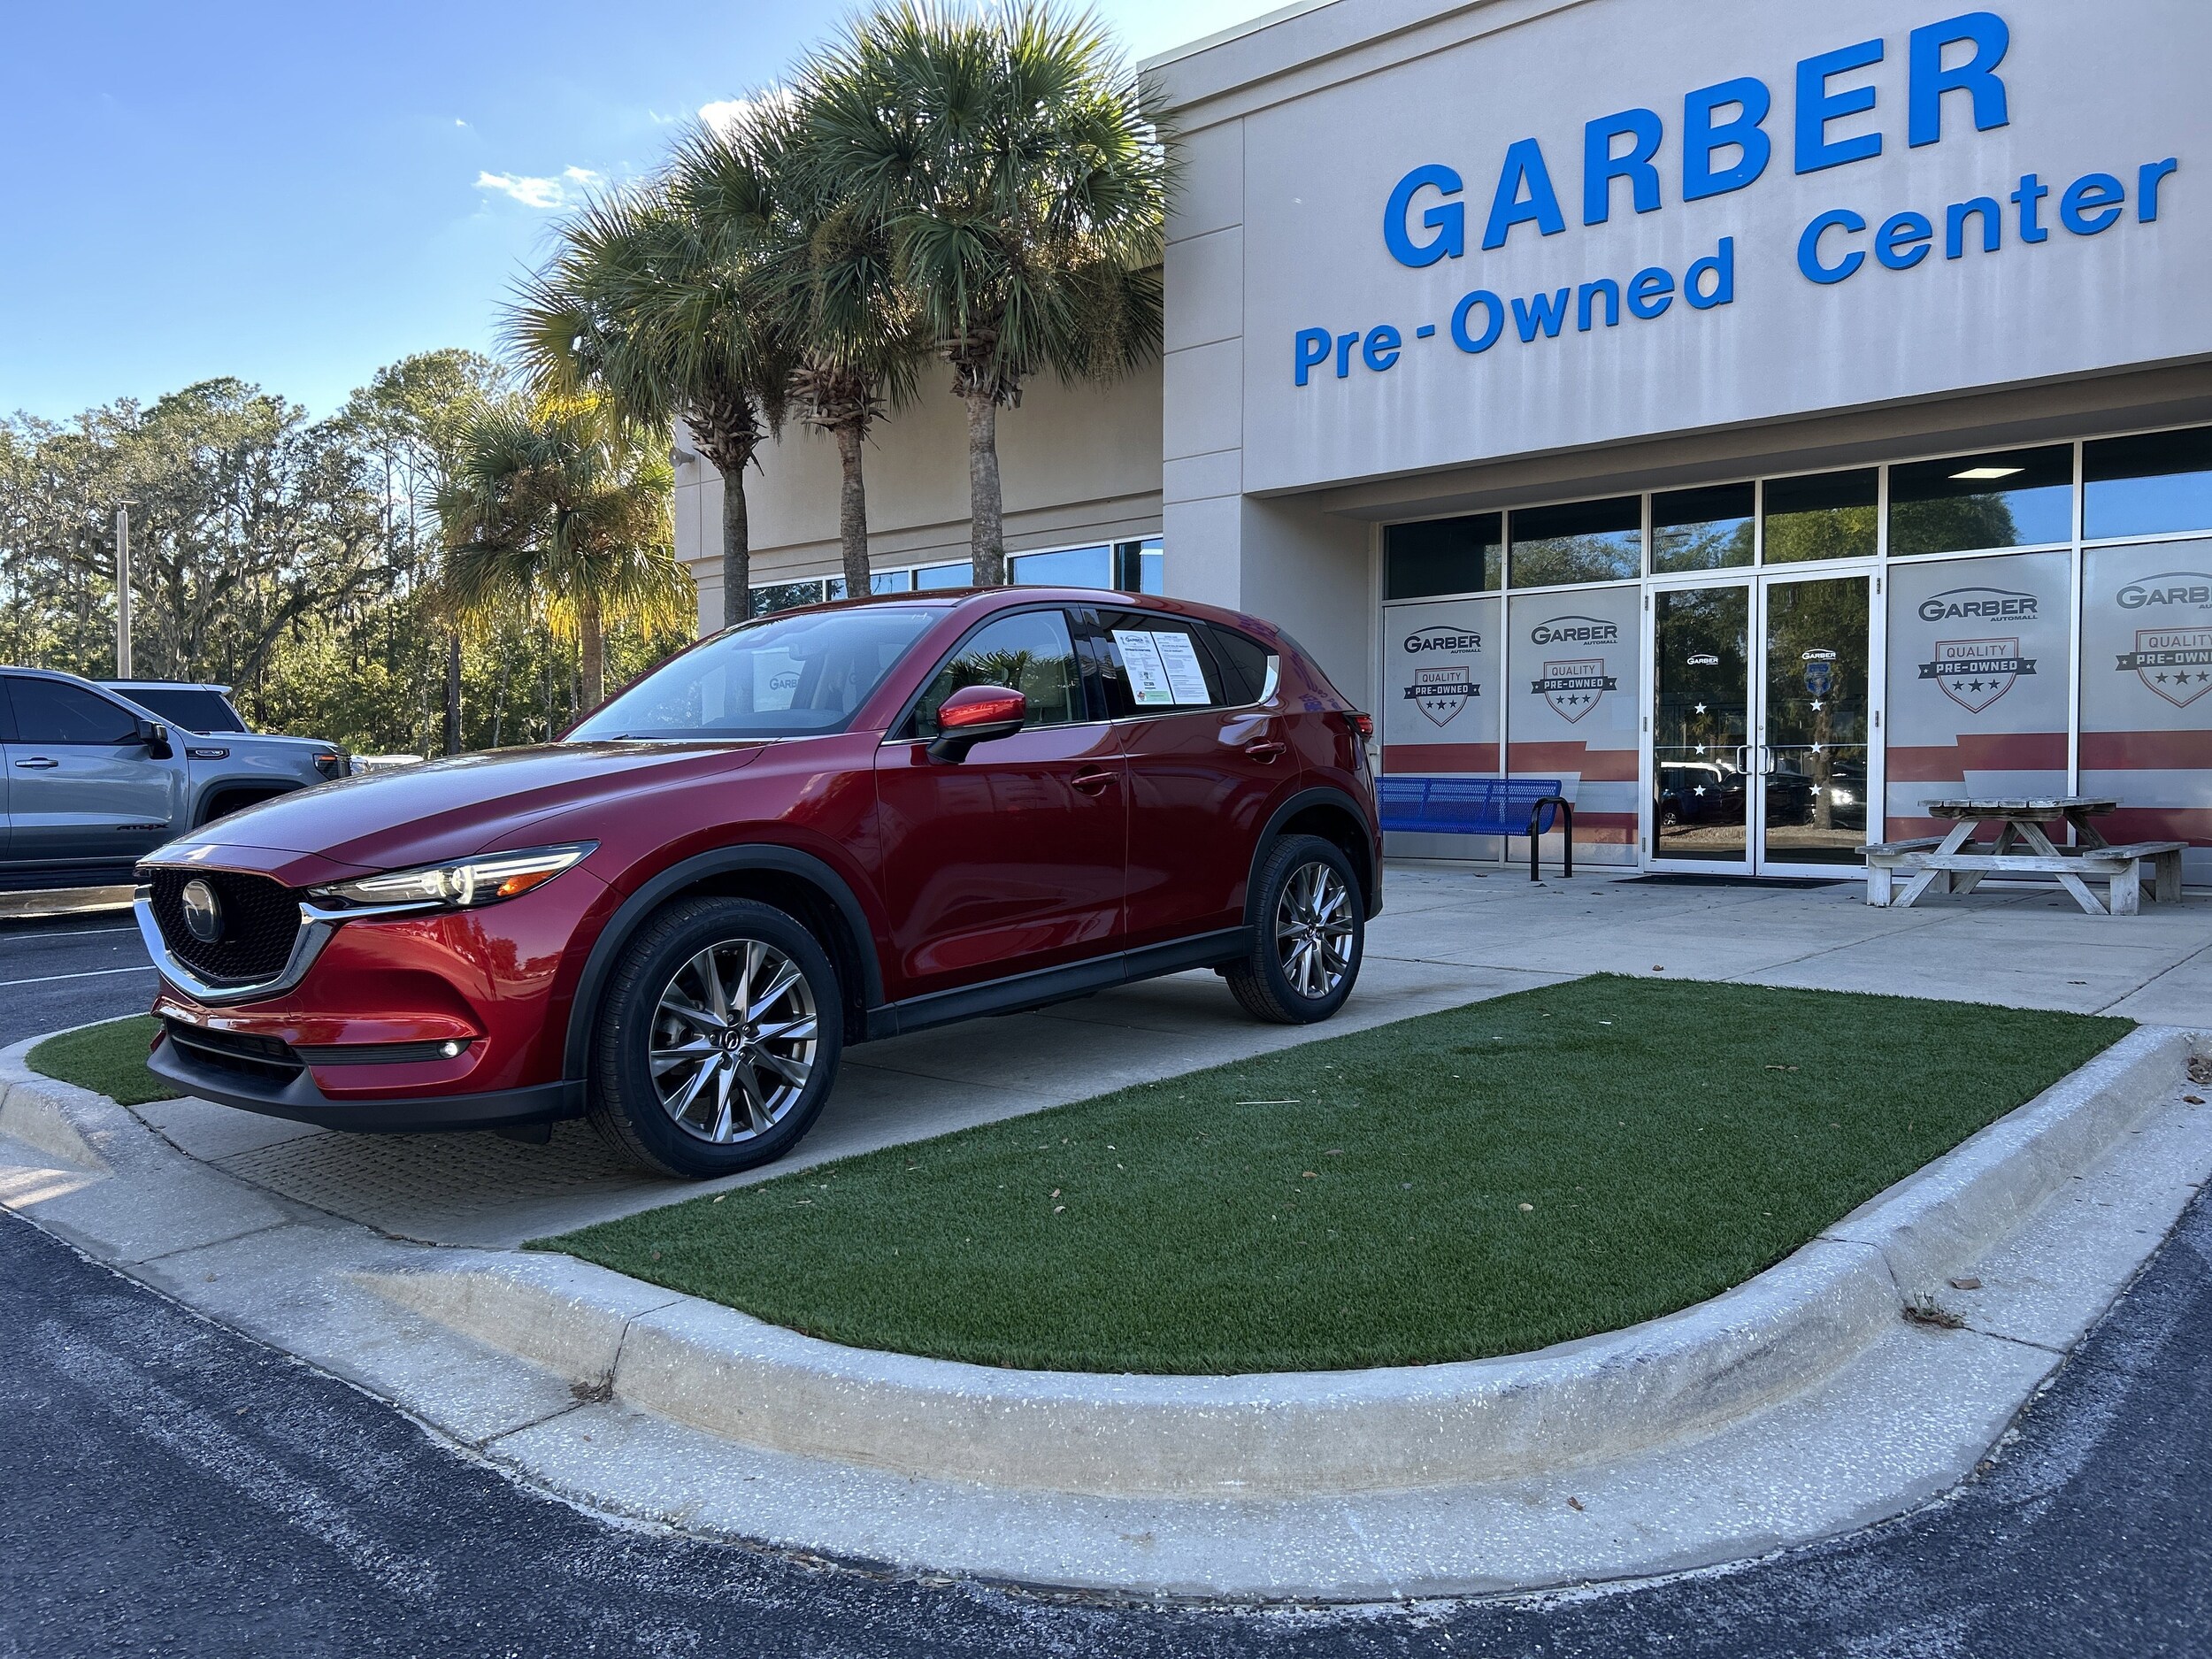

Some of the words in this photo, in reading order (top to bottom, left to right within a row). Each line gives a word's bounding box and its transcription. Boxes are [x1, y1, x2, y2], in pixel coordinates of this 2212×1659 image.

[1384, 12, 2009, 268] GARBER
[1797, 157, 2177, 284] Center
[2116, 586, 2212, 610] GARB
[1918, 598, 2038, 622] GARBER
[1532, 626, 1617, 645] GARBER
[1404, 635, 1481, 653] GARBER
[1947, 645, 2006, 657] QUALITY
[2137, 652, 2212, 664] PRE-OWN
[1552, 665, 1595, 676] QUALITY
[1936, 661, 2017, 673] PRE-OWNED
[1422, 672, 1461, 682] QUALITY
[770, 678, 796, 690] GARB
[1416, 685, 1468, 695] PRE-OWNED
[1544, 679, 1603, 689] PRE-OWNED
